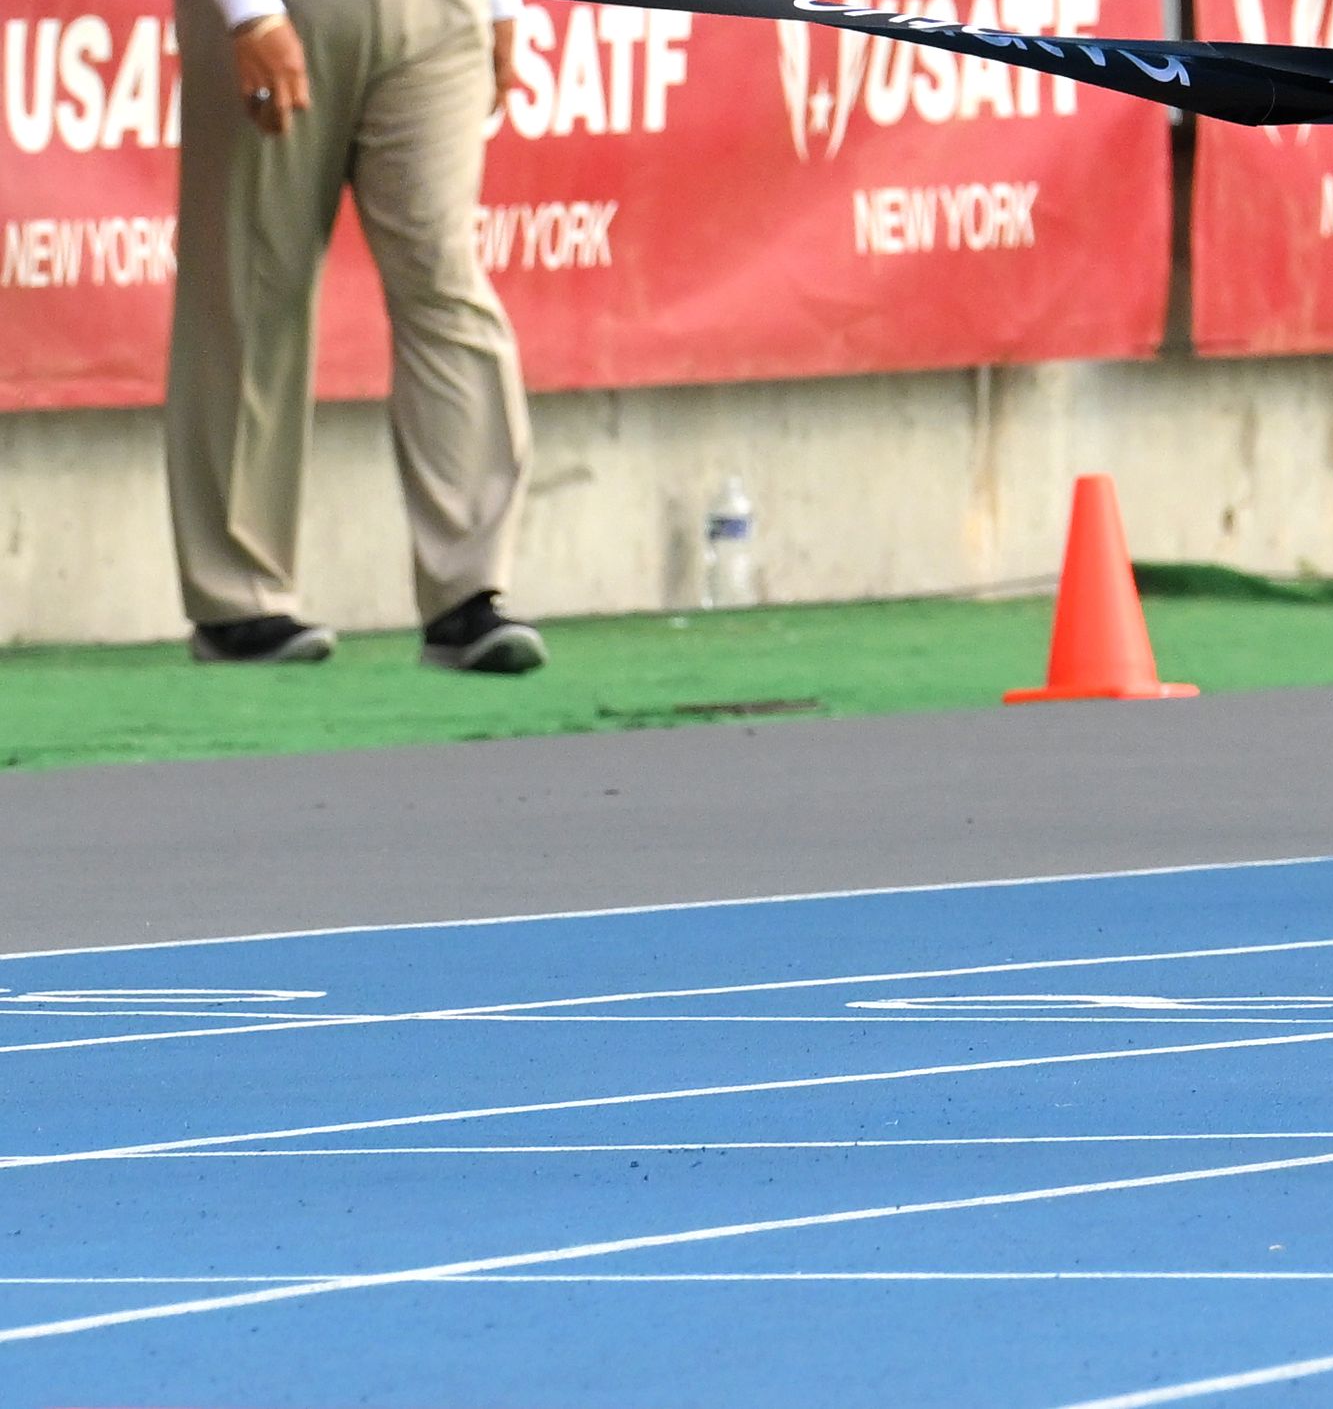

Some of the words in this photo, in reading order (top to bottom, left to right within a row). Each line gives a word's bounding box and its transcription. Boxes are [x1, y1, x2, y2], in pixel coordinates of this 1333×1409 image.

[478, 3, 692, 140] SATF
[0, 218, 86, 288] NEW
[82, 214, 179, 288] YORK
[517, 198, 620, 271] YORK
[853, 186, 940, 257] NEW
[937, 180, 1042, 253] YORK
